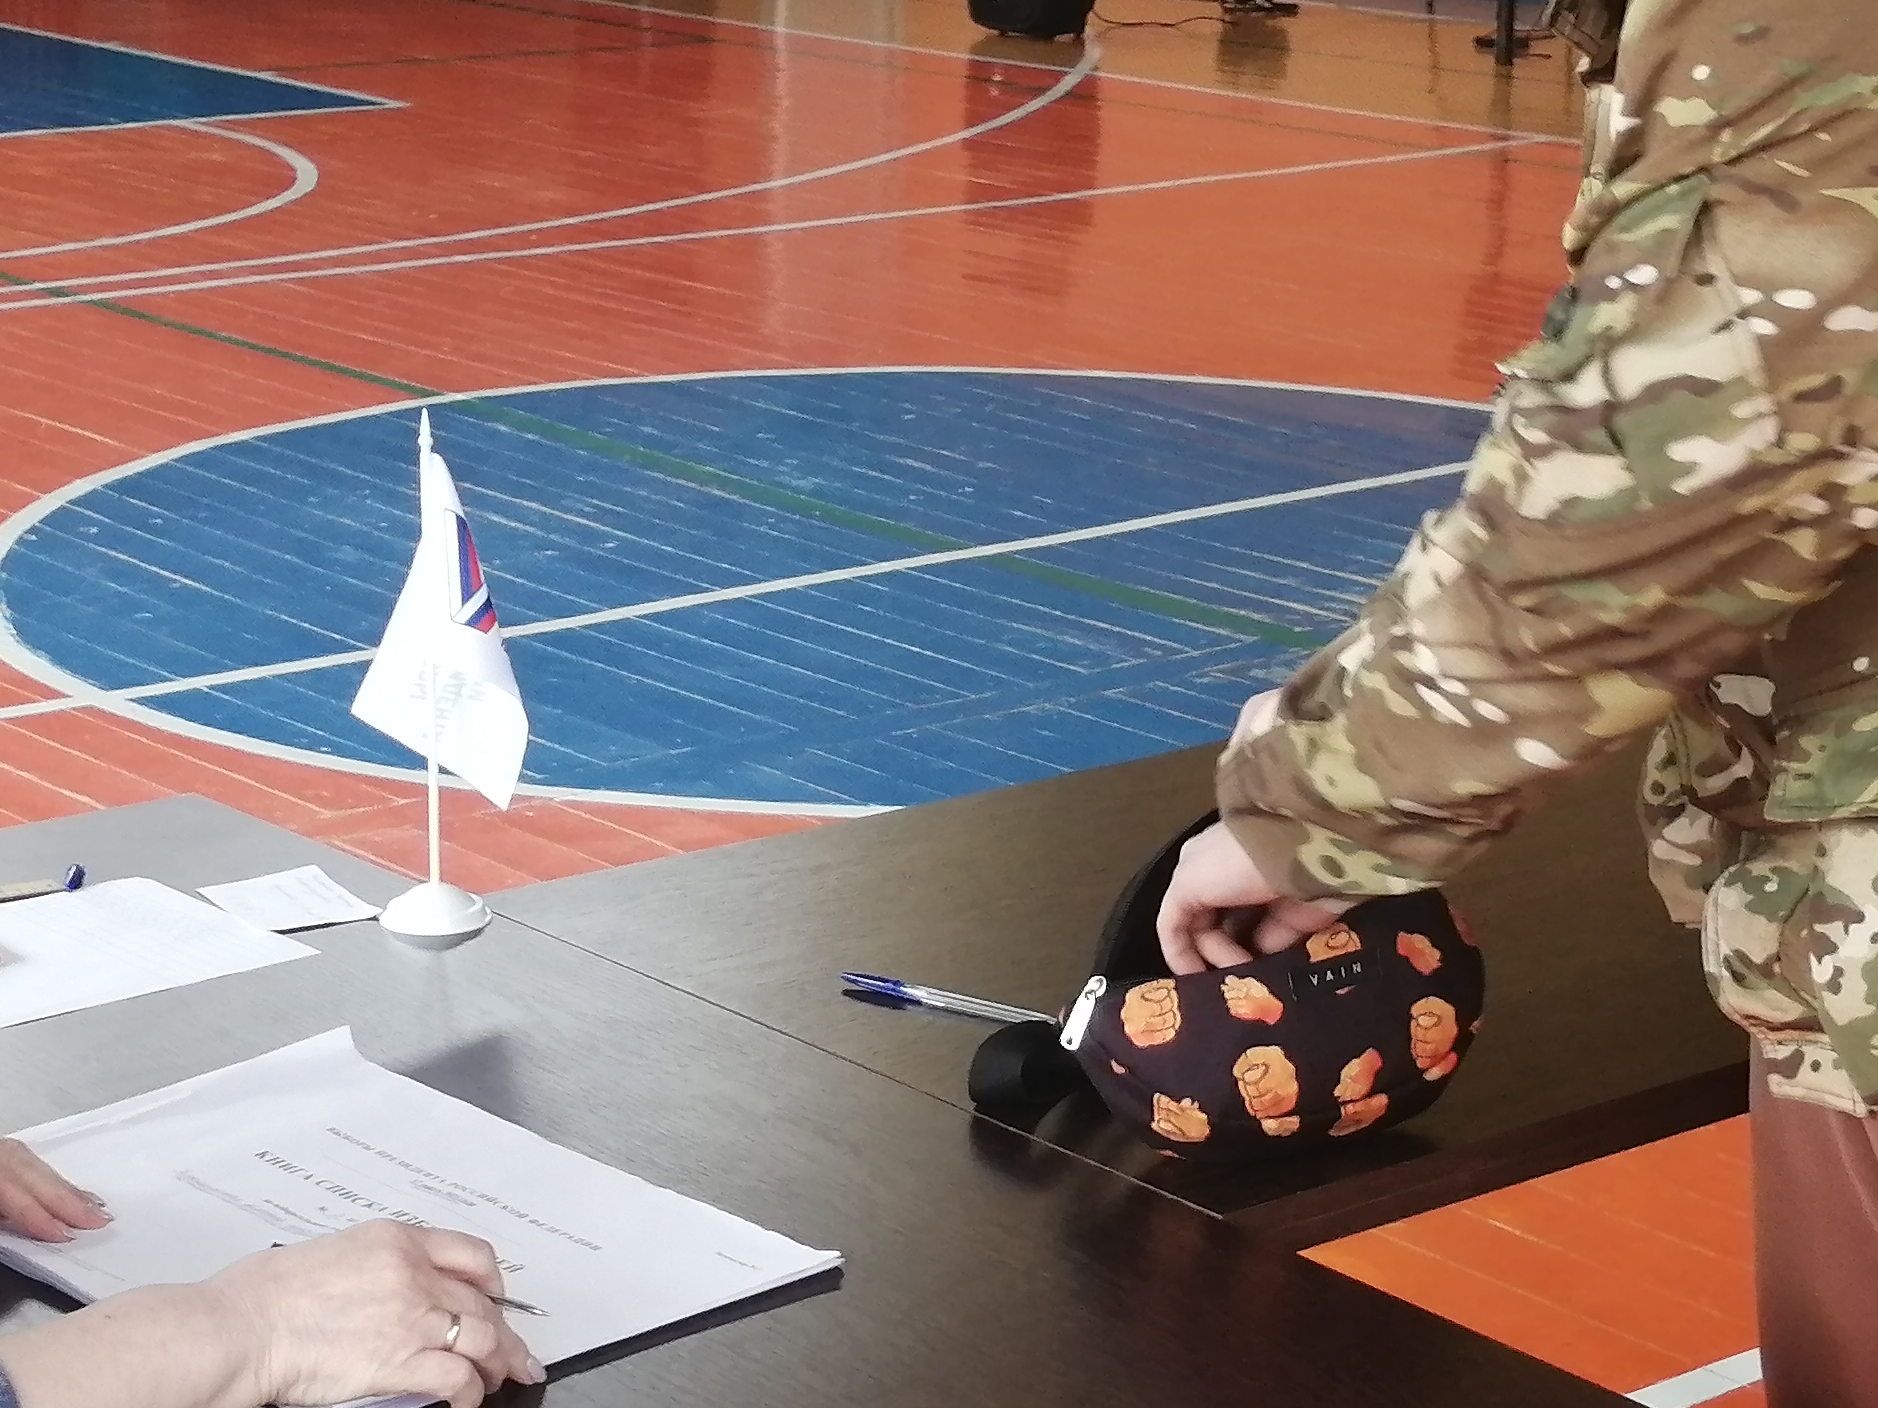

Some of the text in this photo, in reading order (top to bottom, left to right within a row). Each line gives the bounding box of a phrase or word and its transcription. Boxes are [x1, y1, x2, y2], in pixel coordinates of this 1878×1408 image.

[1308, 961, 1362, 986] VAIN
[254, 1150, 314, 1180] КНИГА
[315, 1179, 389, 1212] СПИСКА
